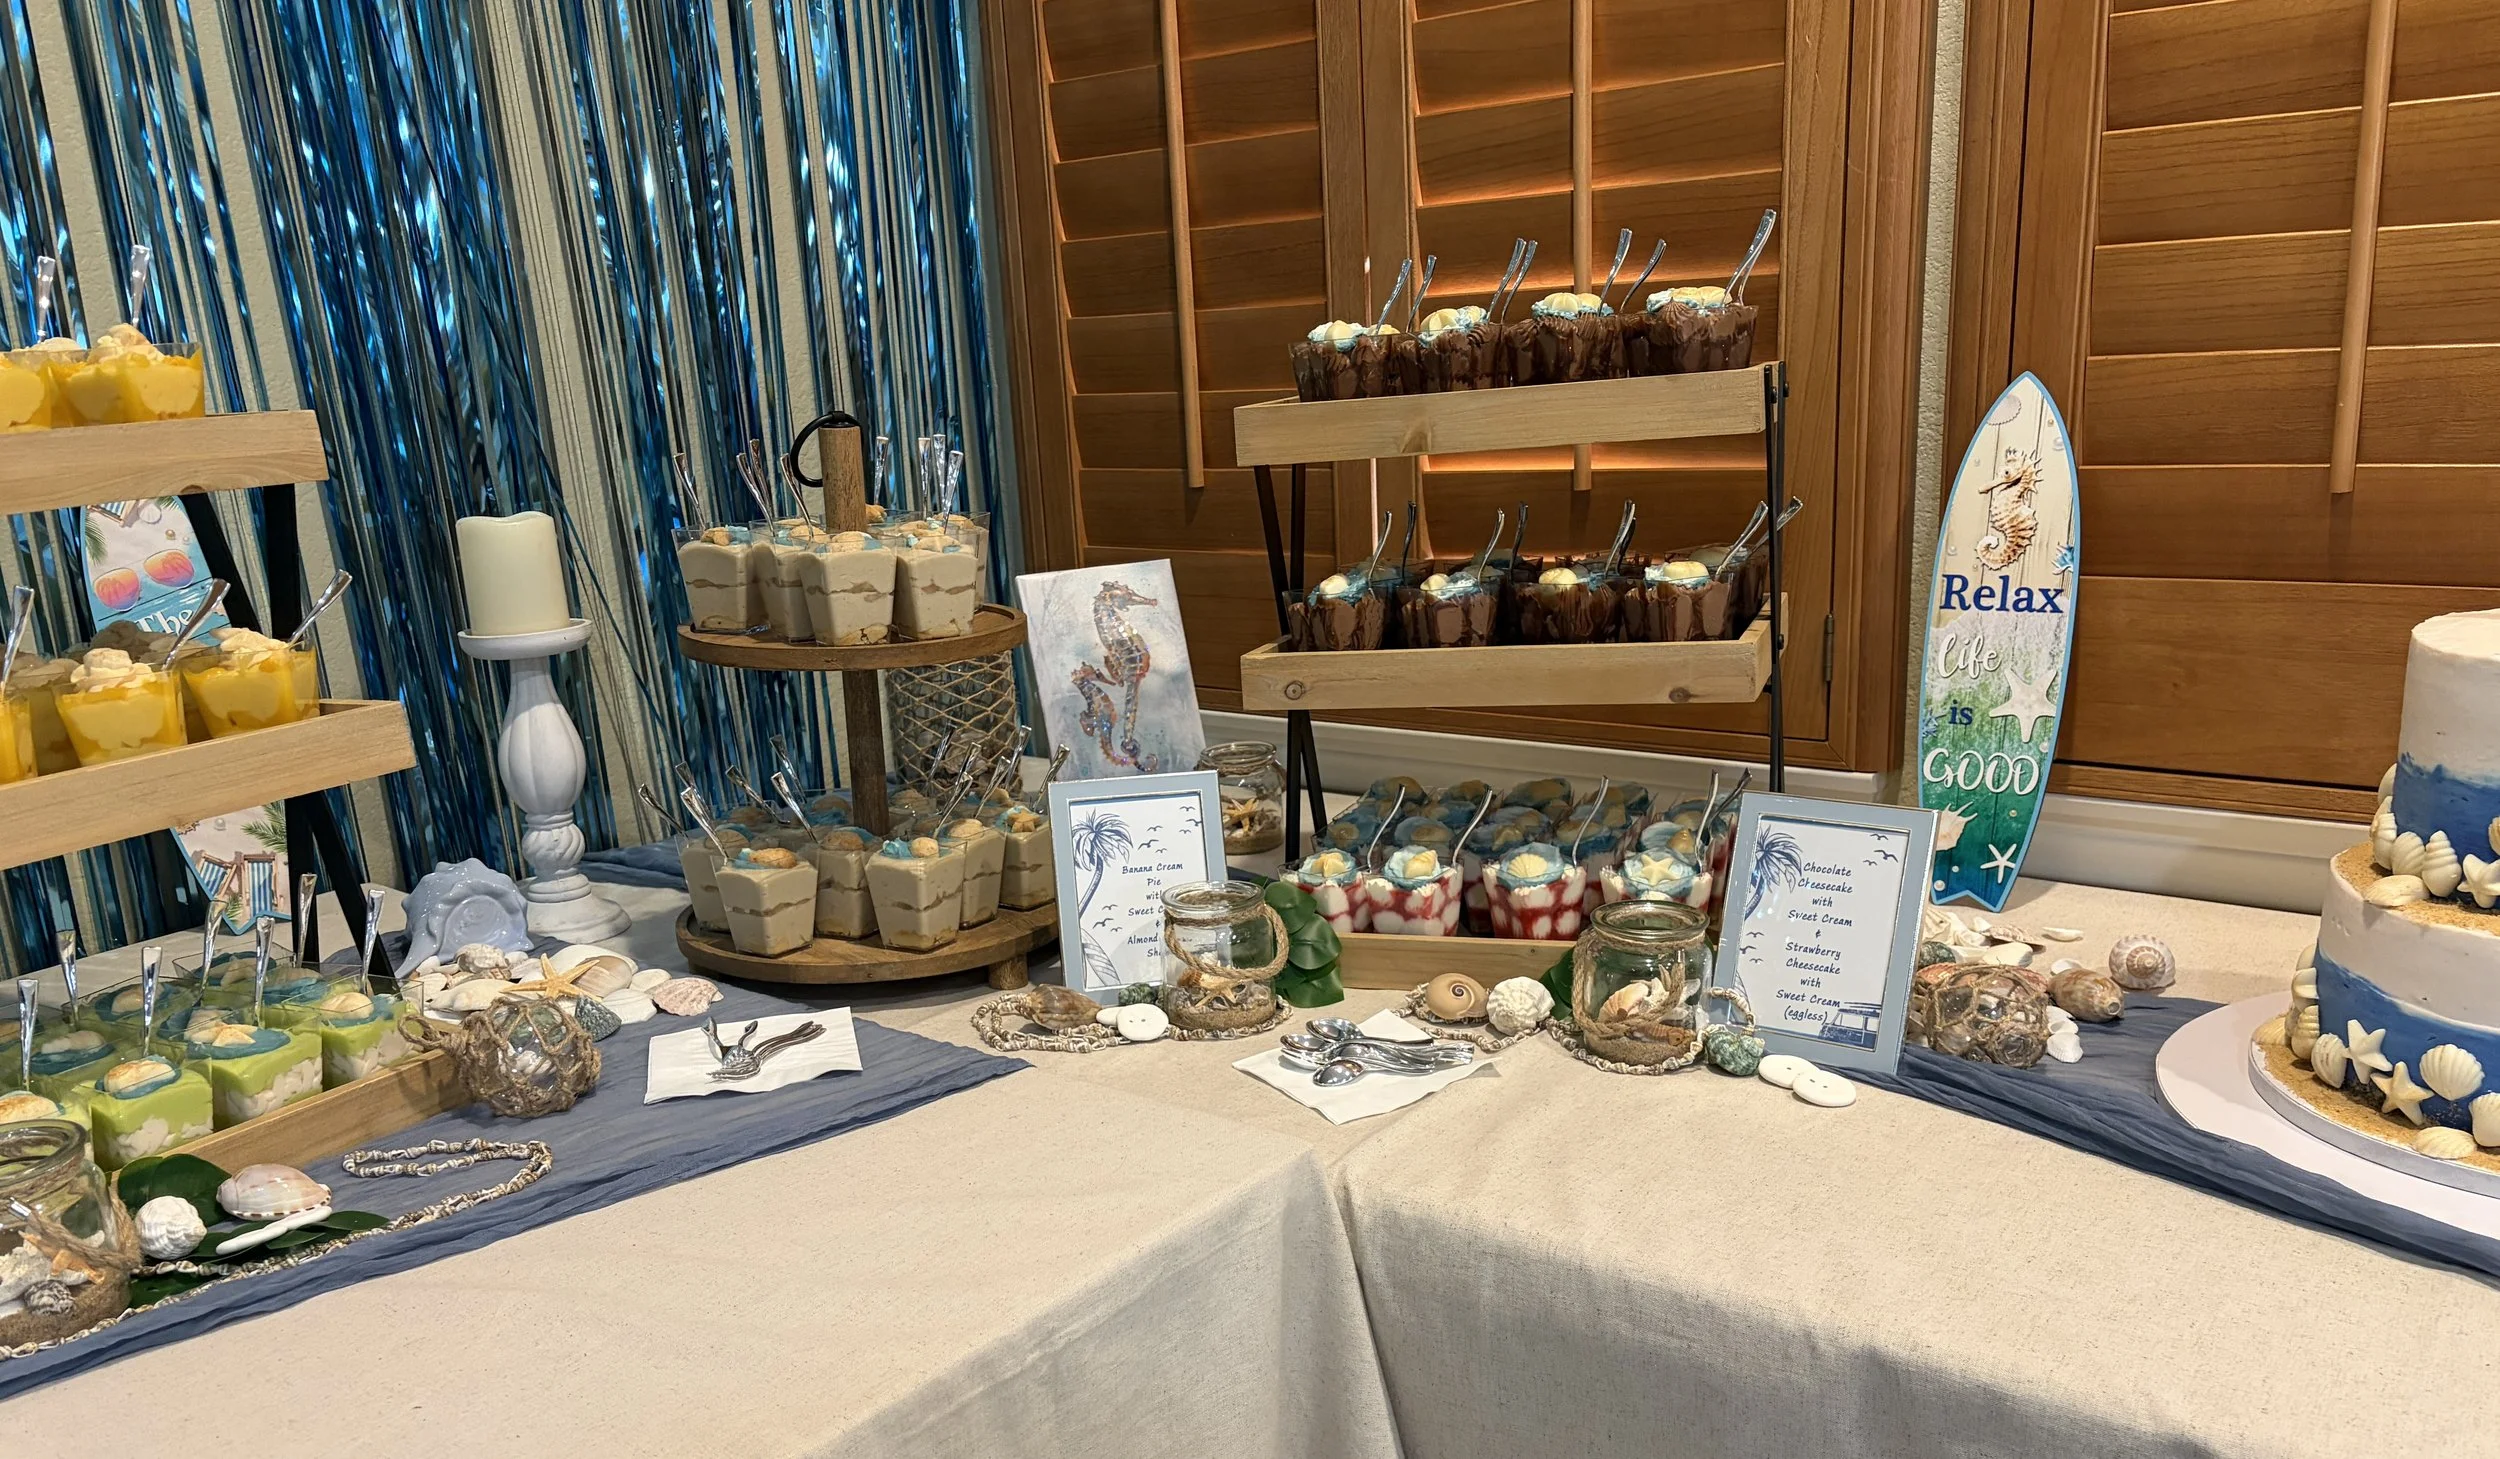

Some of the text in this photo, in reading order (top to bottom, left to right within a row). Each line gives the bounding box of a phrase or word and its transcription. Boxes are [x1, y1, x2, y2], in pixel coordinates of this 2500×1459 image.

[1939, 574, 2064, 614] Relax
[134, 609, 193, 635] The
[1937, 633, 2001, 679] life
[1948, 699, 1974, 725] is
[1923, 747, 2040, 796] GOOD
[1122, 863, 1183, 875] Banana Cream
[1804, 861, 1852, 877] Chocolate
[1147, 877, 1161, 887] Pie
[1812, 896, 1833, 907] with
[1128, 907, 1154, 917] Sweet
[1821, 913, 1853, 927] Cream
[1127, 933, 1158, 944] Almond
[1785, 941, 1841, 961] Strawberry
[1786, 957, 1841, 975] Cheesecake
[1800, 976, 1821, 988] with
[1776, 989, 1840, 1008] Sweet Cream
[1784, 1005, 1828, 1026] (eggless)
